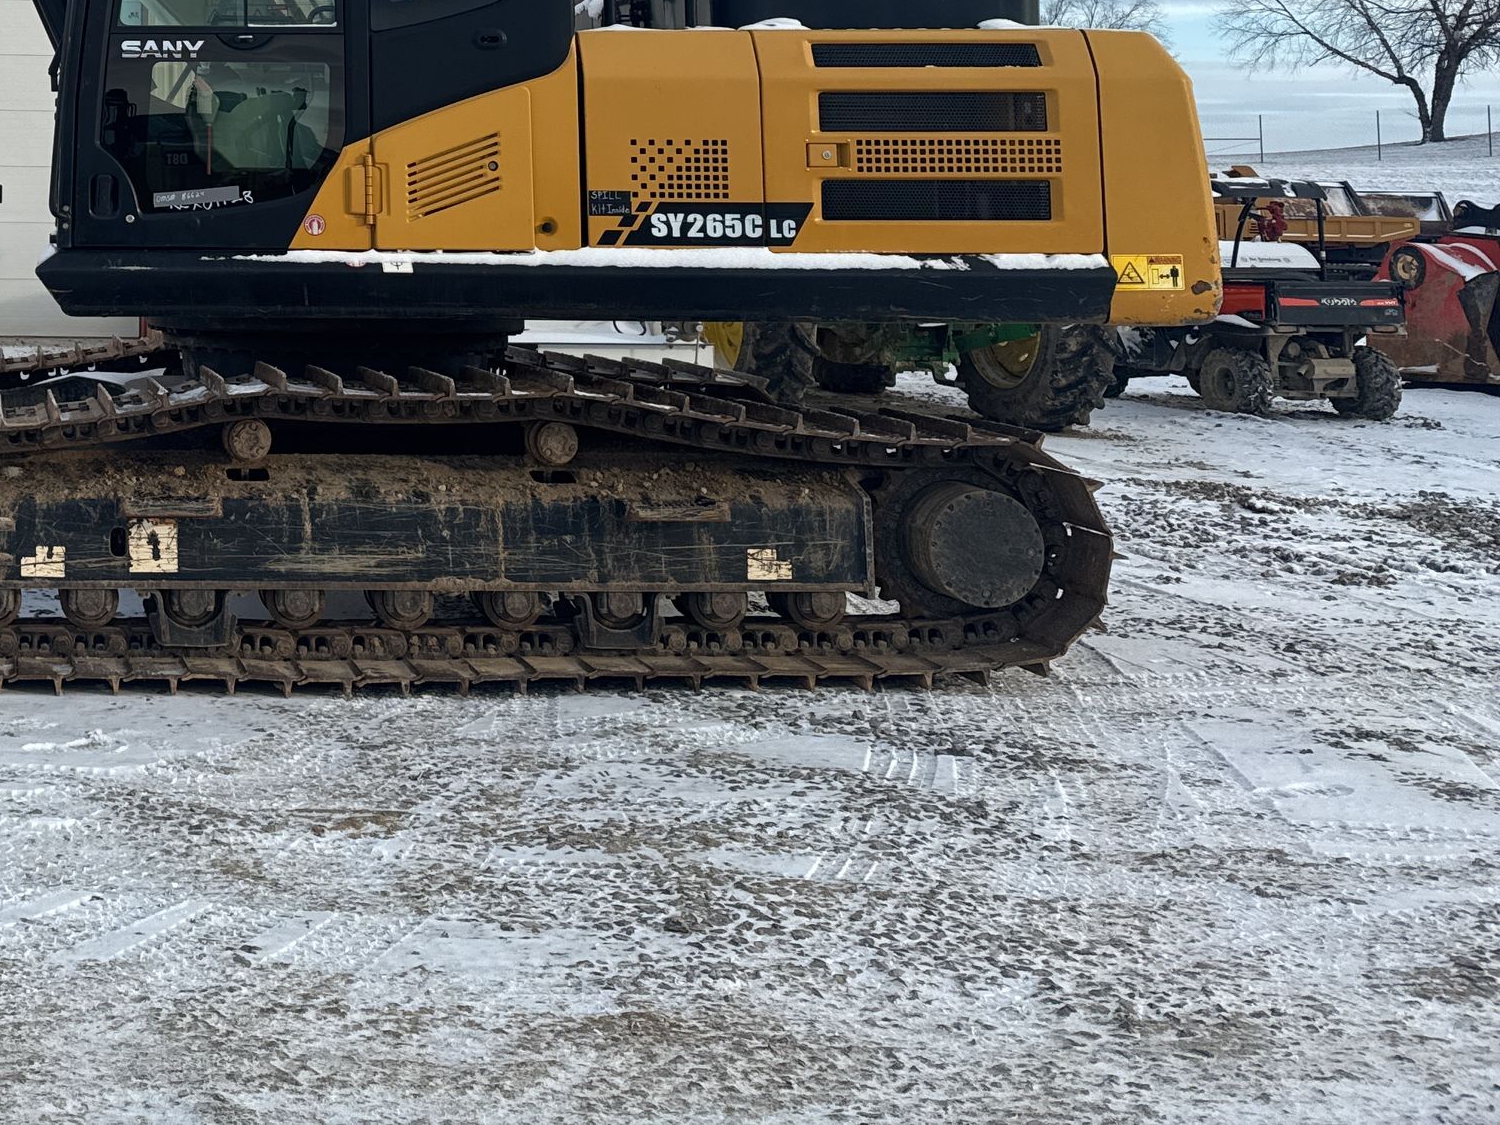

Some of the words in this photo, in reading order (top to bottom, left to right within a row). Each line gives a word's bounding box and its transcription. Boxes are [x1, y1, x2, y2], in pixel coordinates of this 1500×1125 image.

[121, 40, 205, 58] SANY
[590, 190, 622, 200] SPILL
[650, 213, 763, 238] SY265C
[769, 219, 797, 238] LC
[1320, 297, 1358, 306] Kubota
